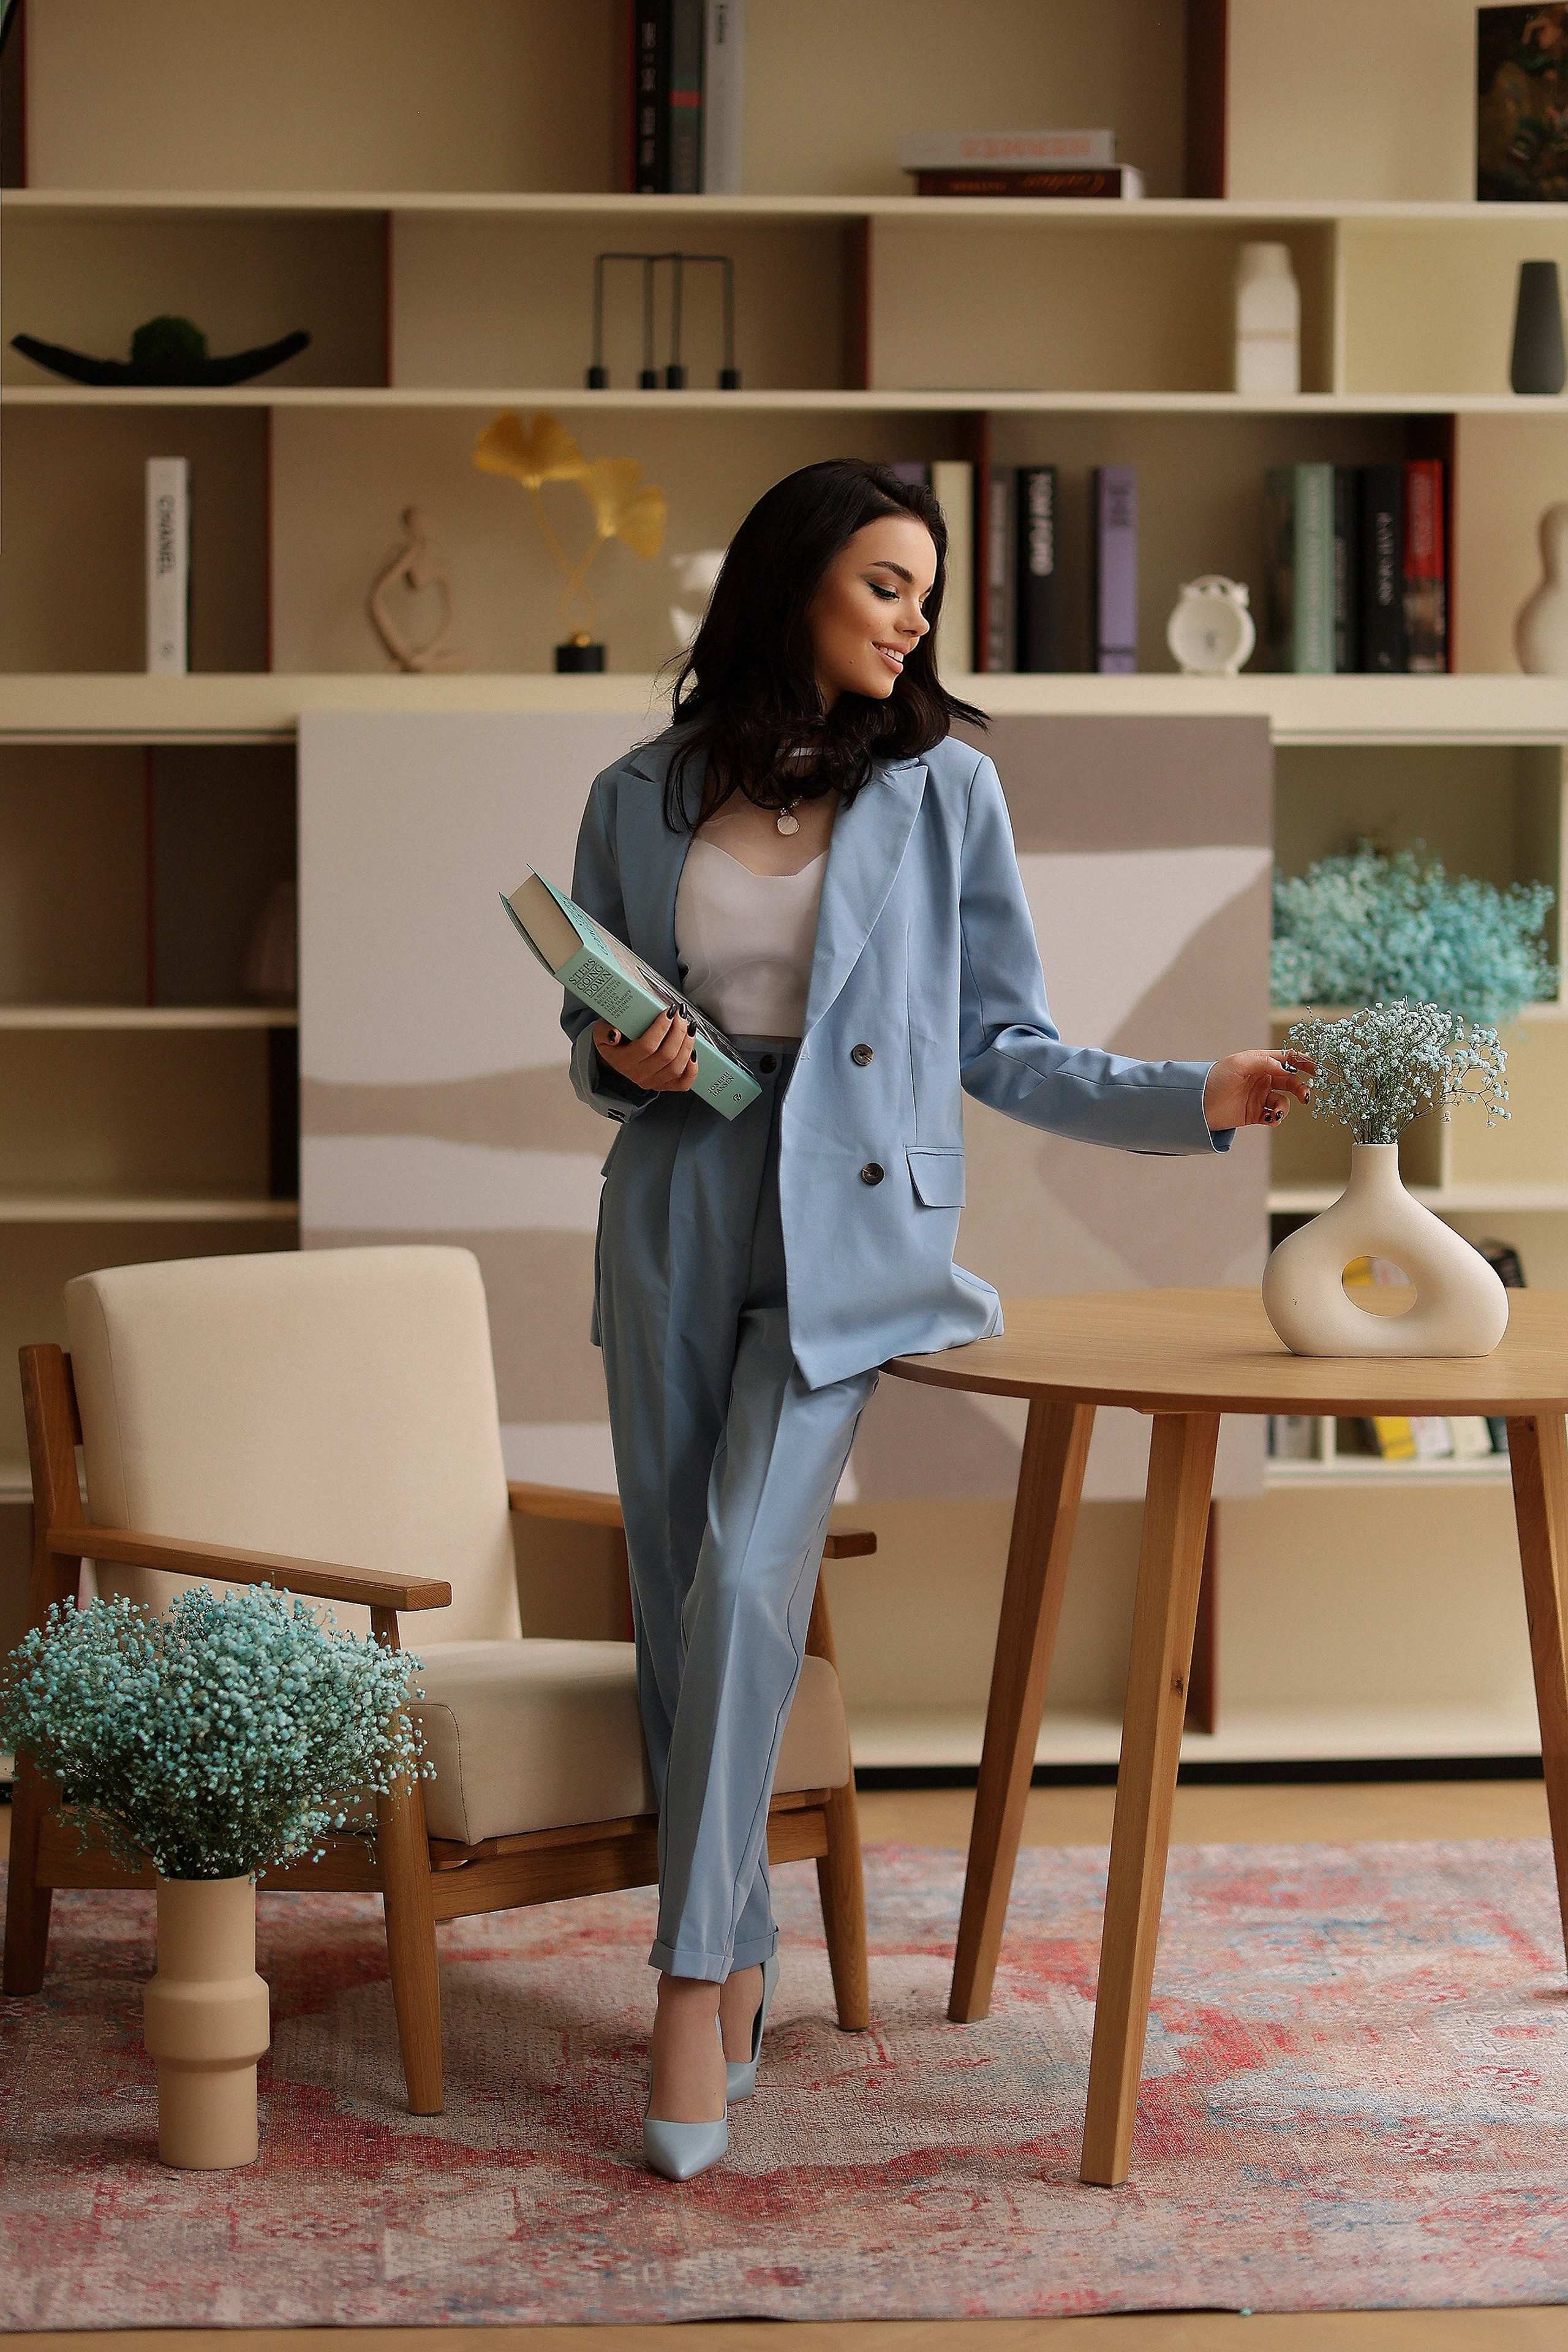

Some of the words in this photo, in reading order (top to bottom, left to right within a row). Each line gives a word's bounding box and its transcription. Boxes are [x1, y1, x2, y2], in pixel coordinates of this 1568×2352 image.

[569, 959, 596, 985] STEPS
[577, 965, 604, 990] GOING
[584, 970, 612, 997] DOWN
[707, 1071, 729, 1093] JOSEPH
[712, 1076, 734, 1097] HANSEN
